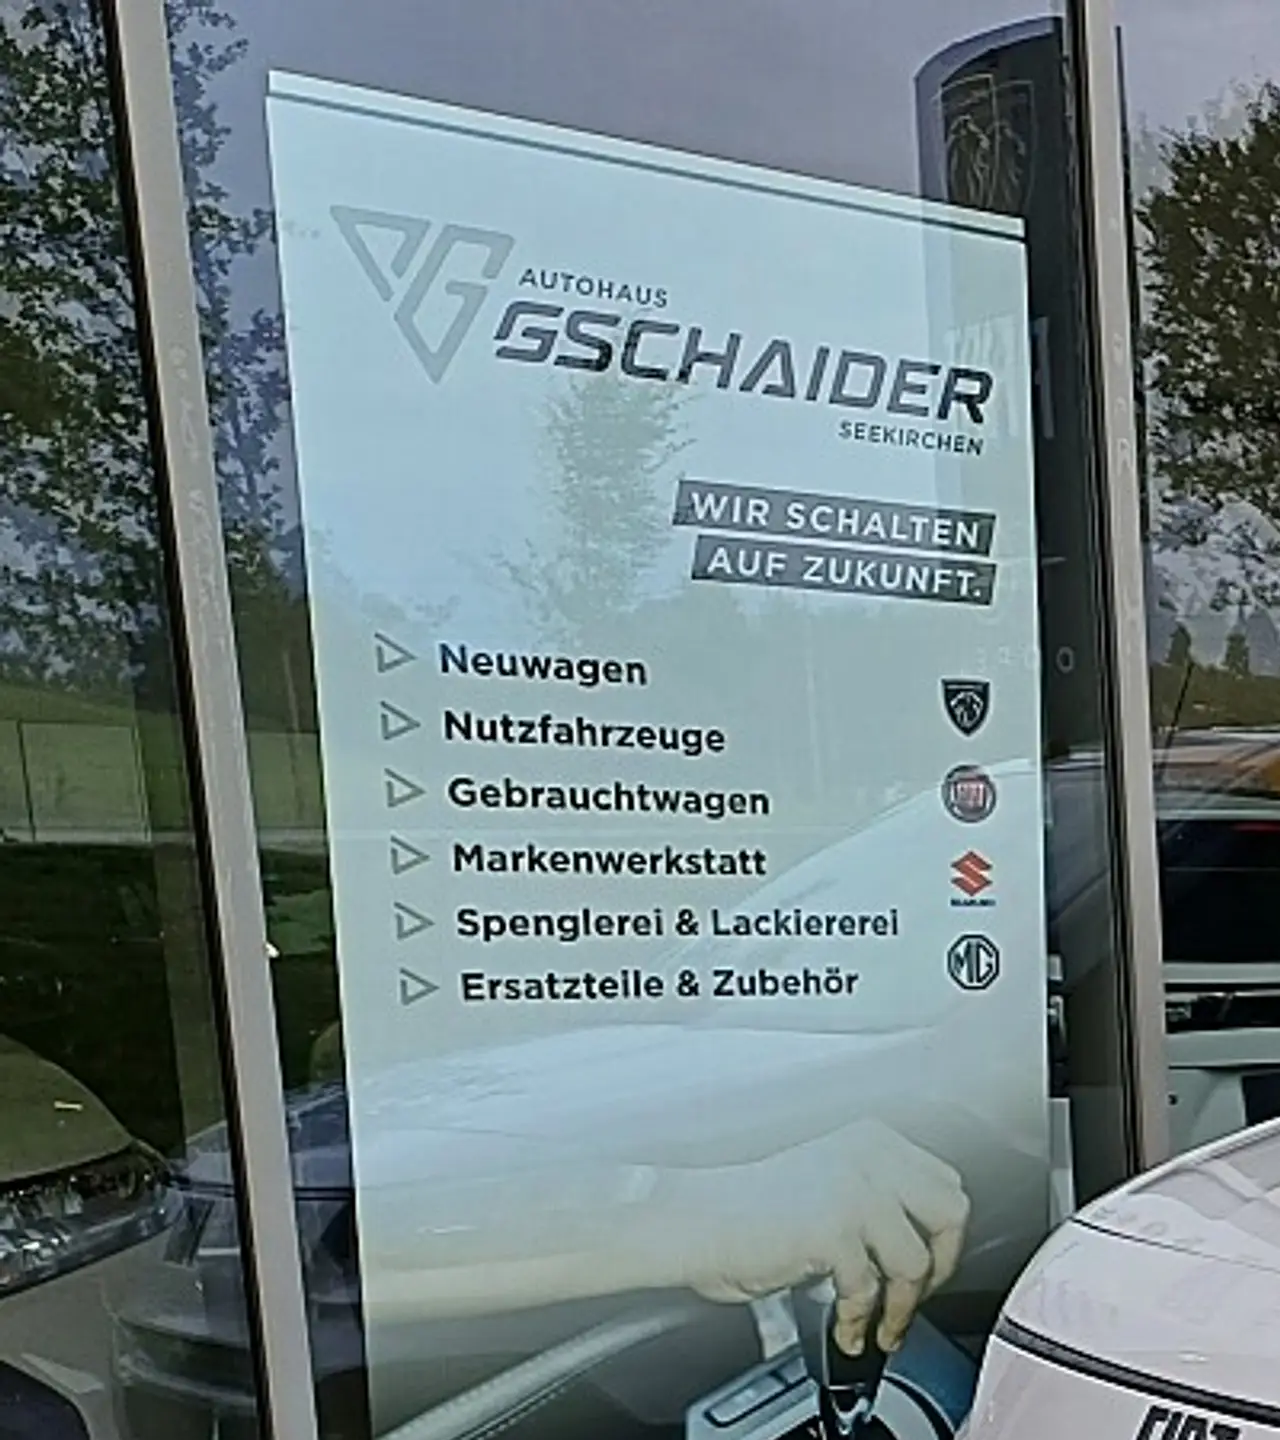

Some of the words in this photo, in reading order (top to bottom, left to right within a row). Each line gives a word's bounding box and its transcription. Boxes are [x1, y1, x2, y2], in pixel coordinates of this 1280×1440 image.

[518, 268, 668, 308] AUTOHAUS
[493, 300, 994, 425] GSCHAIDER
[838, 421, 985, 457] SEEKIRCHEN
[690, 491, 771, 529] WIR
[784, 503, 980, 549] SCHALTEN
[705, 545, 786, 579] AUF
[801, 555, 983, 598] ZUKUNFT.
[438, 643, 648, 687] Neuwagen
[444, 710, 726, 755] Nutzfahrzeuge
[447, 777, 770, 816] Gebrauchtwagen
[453, 843, 767, 877] Markenwerkstatt
[456, 908, 664, 942] Spenglerei
[675, 911, 700, 937] &
[711, 908, 899, 937] Lackiererei
[461, 967, 665, 1002] Ersatzteile
[675, 971, 701, 998] &
[713, 966, 859, 998] Zubehör
